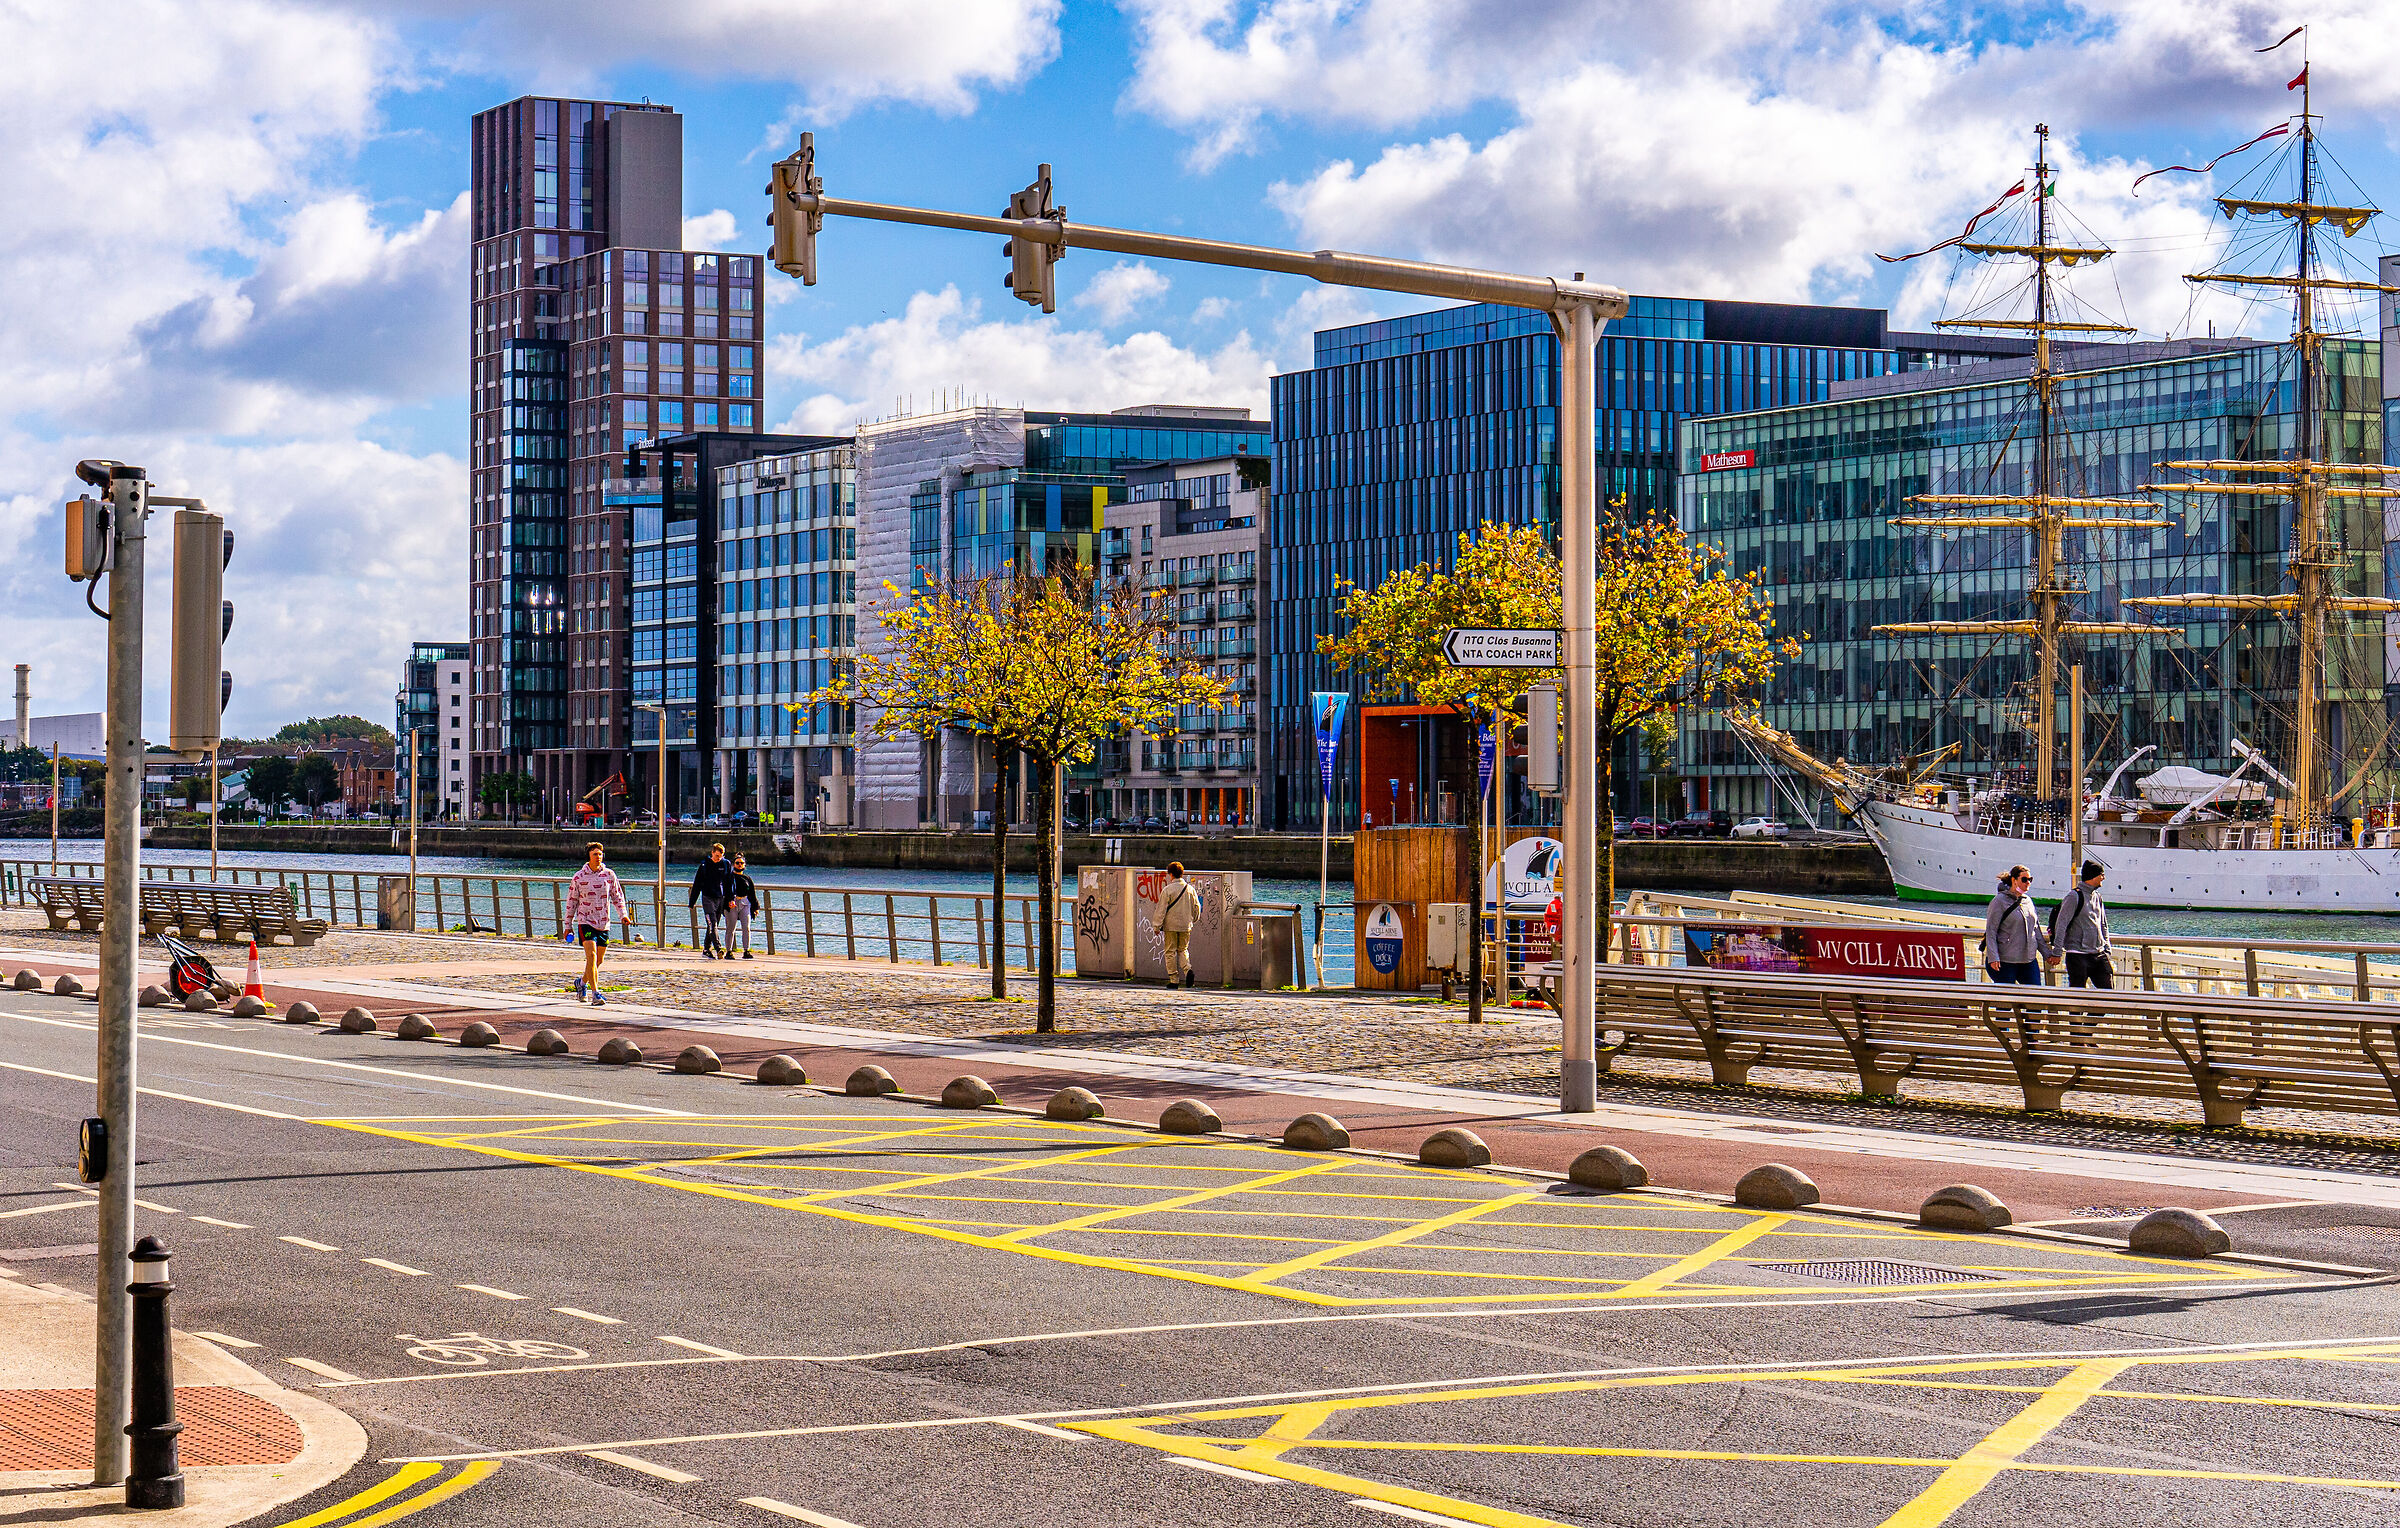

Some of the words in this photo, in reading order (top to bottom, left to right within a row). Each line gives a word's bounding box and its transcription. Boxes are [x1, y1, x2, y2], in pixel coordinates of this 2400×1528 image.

[1706, 454, 1747, 468] Matheson
[1512, 636, 1552, 646] Busanna
[1462, 649, 1483, 658] NTA
[1486, 649, 1522, 658] COACH
[1526, 650, 1553, 659] PARK
[1515, 882, 1541, 893] CILL
[1373, 943, 1396, 953] COFFEE
[1375, 954, 1393, 964] DOCK
[1816, 939, 1841, 959] MV
[1844, 941, 1891, 966] CILL
[1894, 943, 1958, 971] AIRNE
